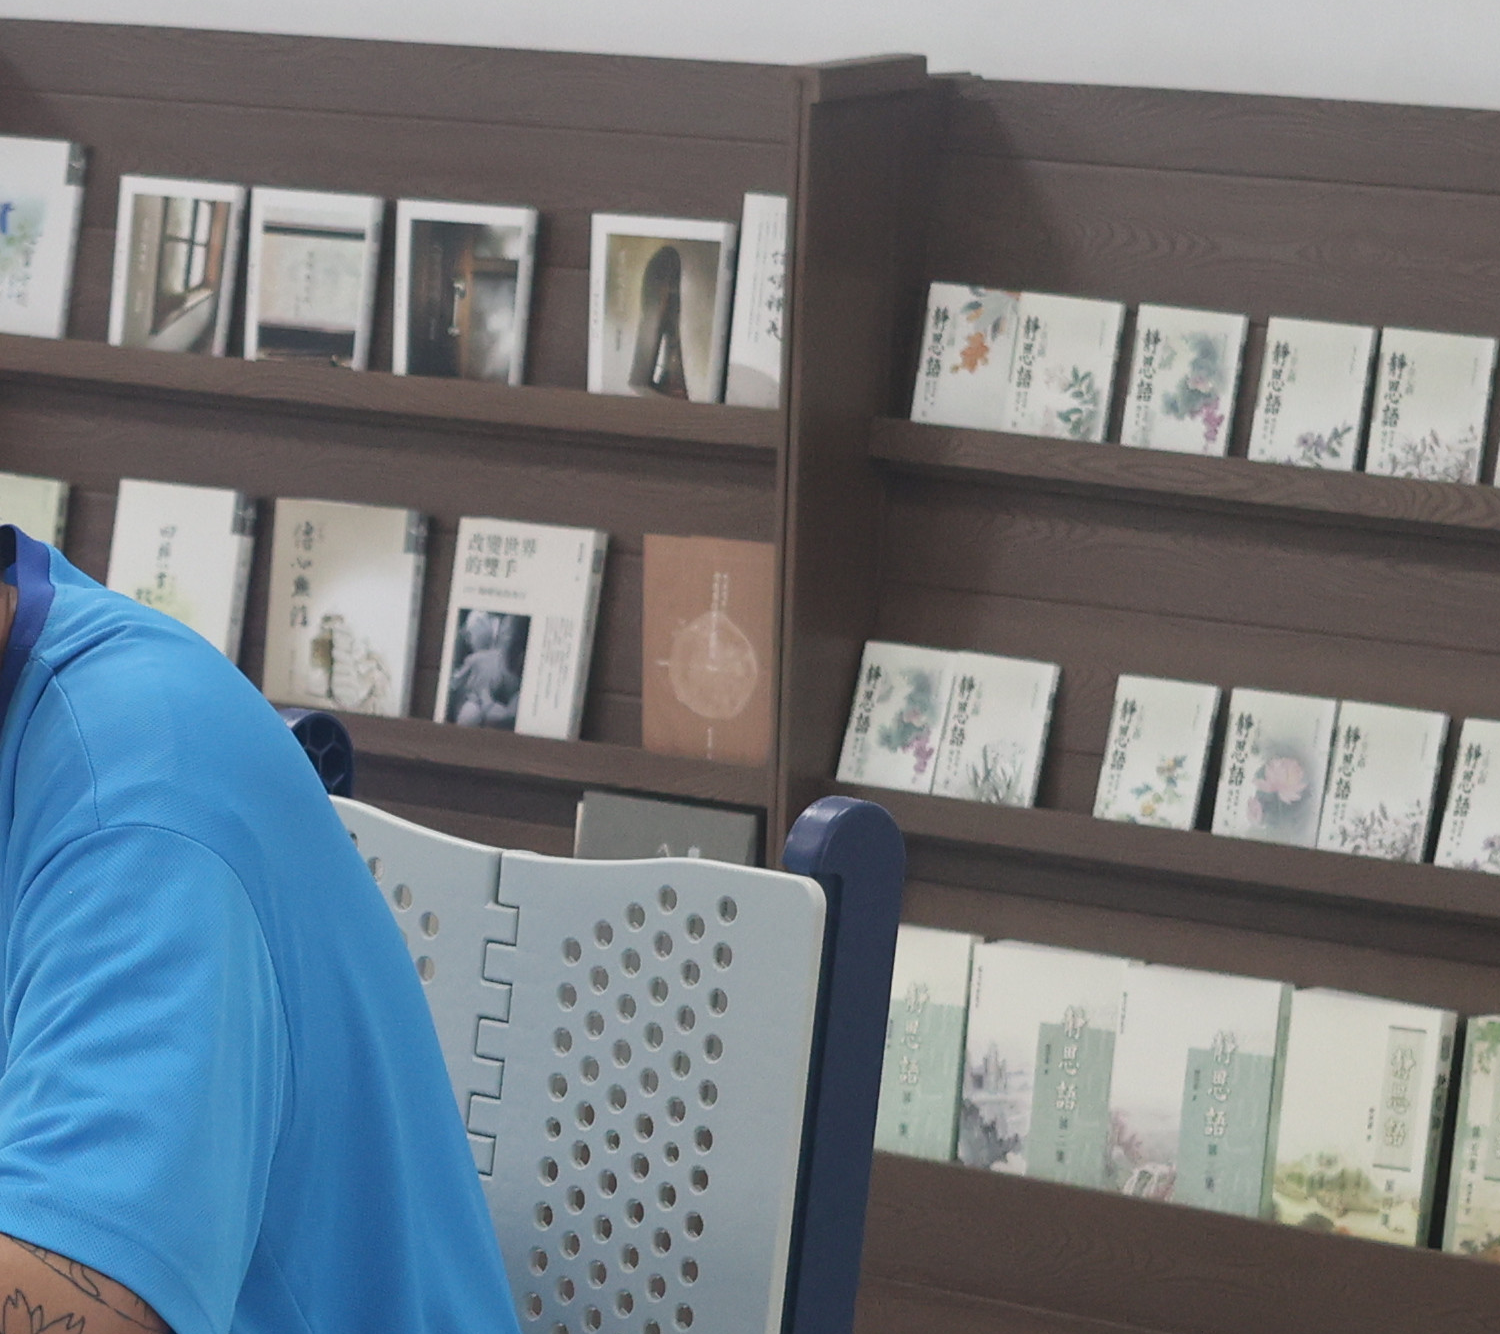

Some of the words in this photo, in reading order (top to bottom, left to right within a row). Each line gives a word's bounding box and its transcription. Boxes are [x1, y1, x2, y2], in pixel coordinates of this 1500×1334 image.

[468, 533, 537, 558] 改變世界
[465, 556, 517, 578] 的雙手
